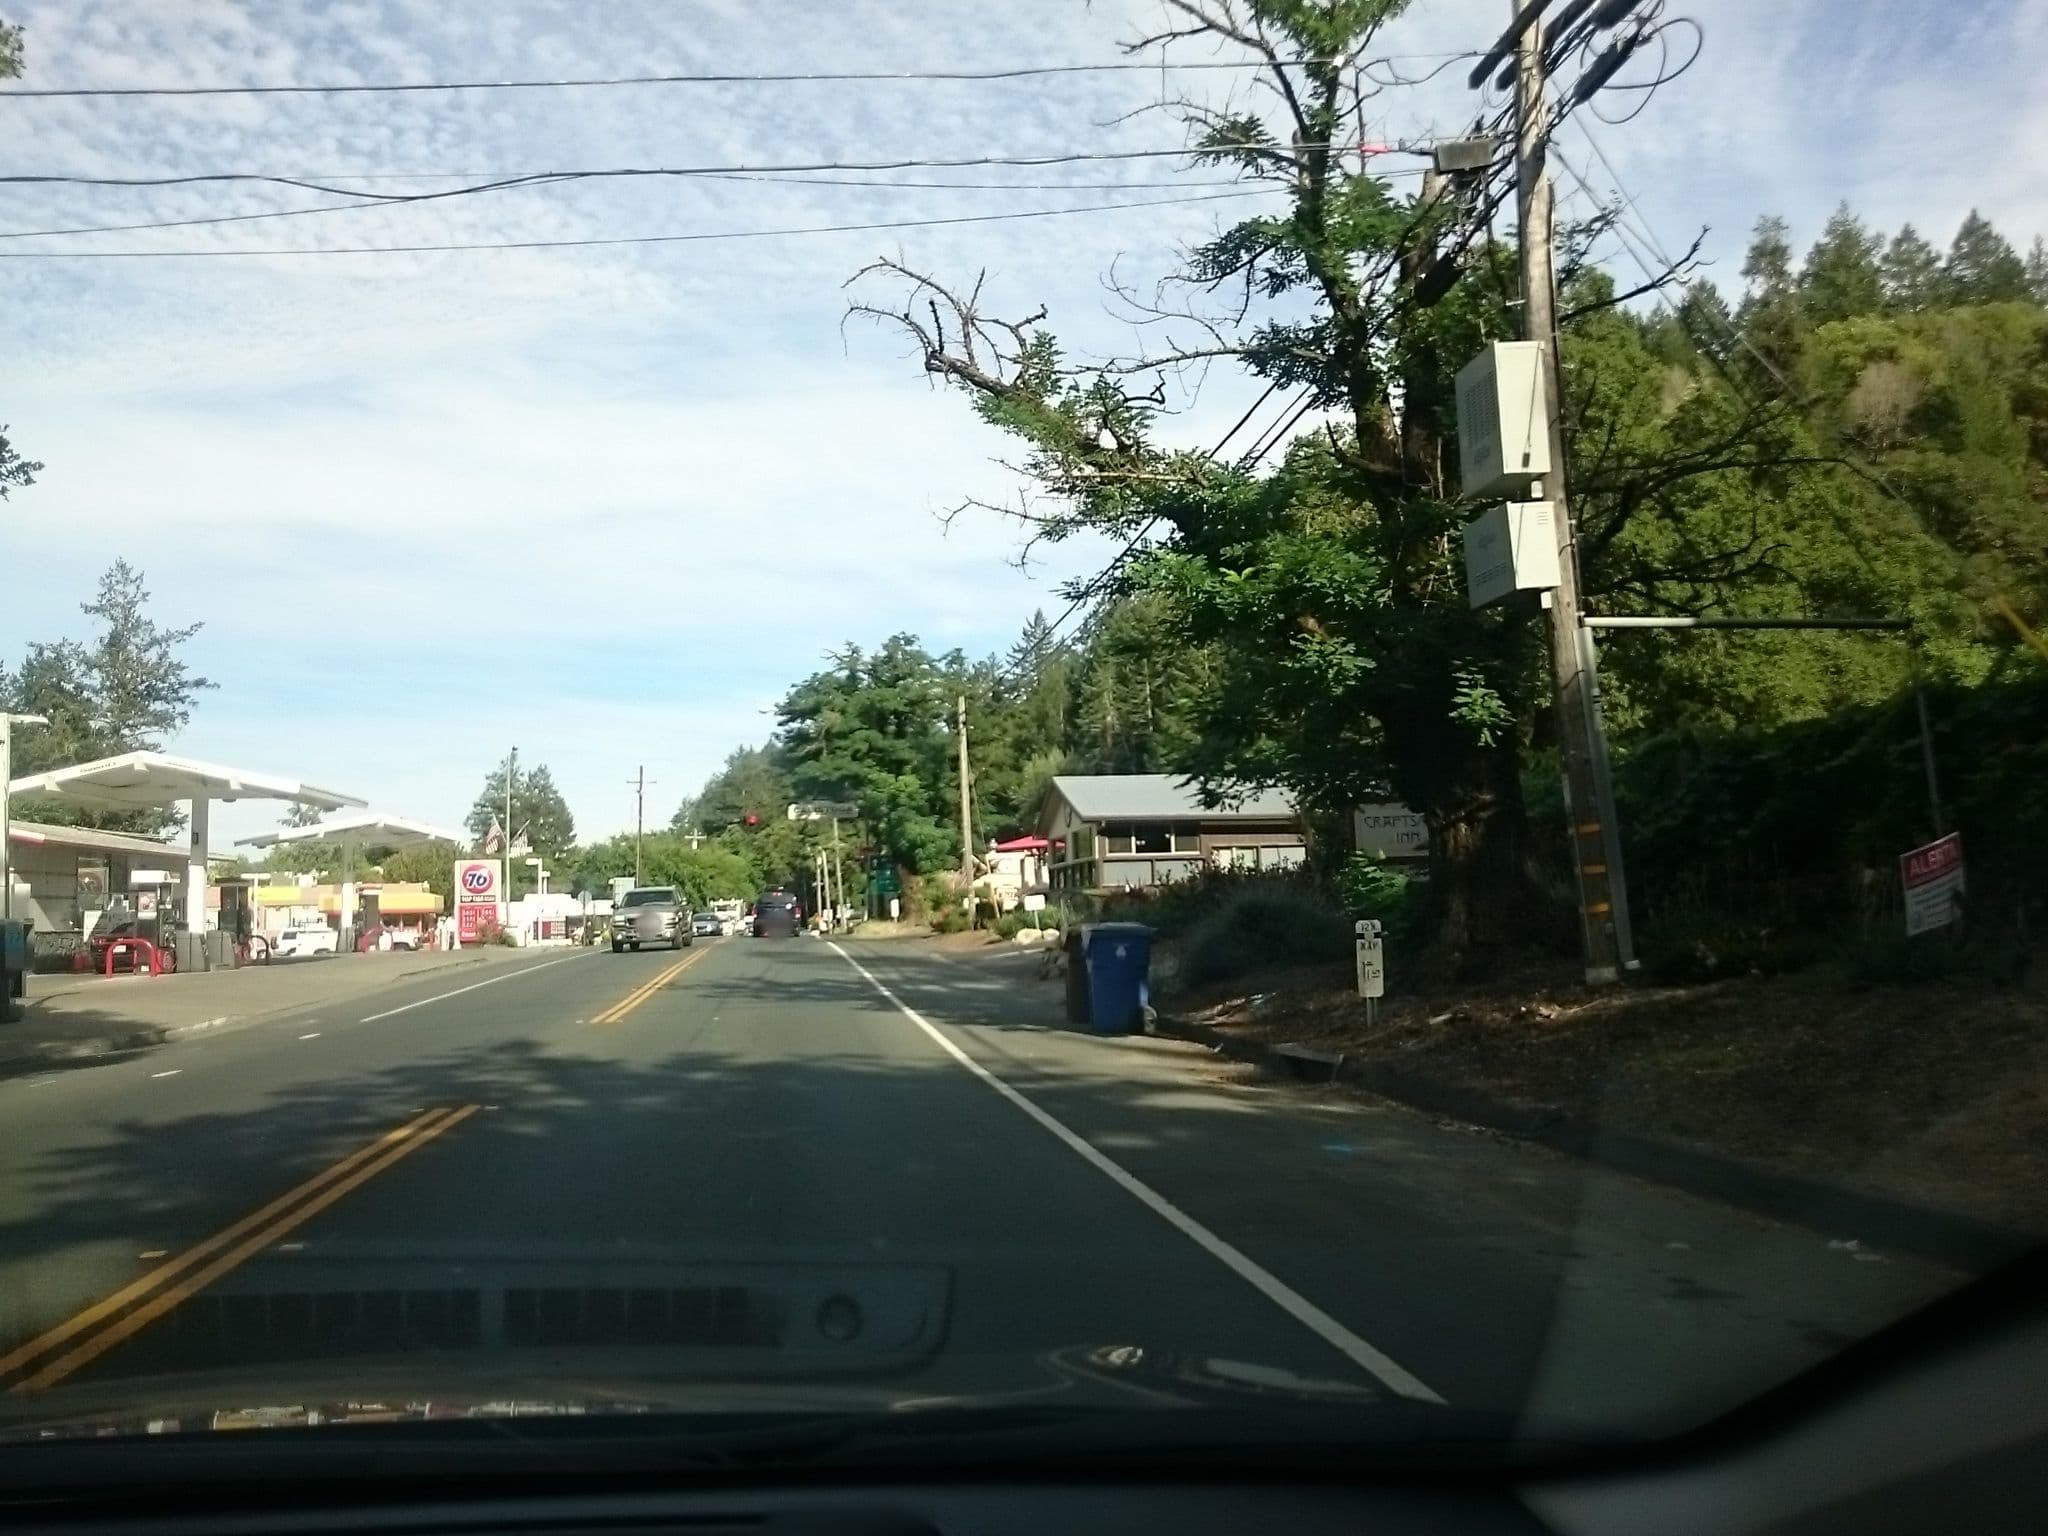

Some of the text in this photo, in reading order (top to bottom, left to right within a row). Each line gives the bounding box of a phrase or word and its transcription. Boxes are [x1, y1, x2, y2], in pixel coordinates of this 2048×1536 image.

[1364, 815, 1417, 829] CRAFTS
[1396, 832, 1420, 844] INN
[1911, 842, 1954, 878] ALERT
[467, 872, 488, 888] 76
